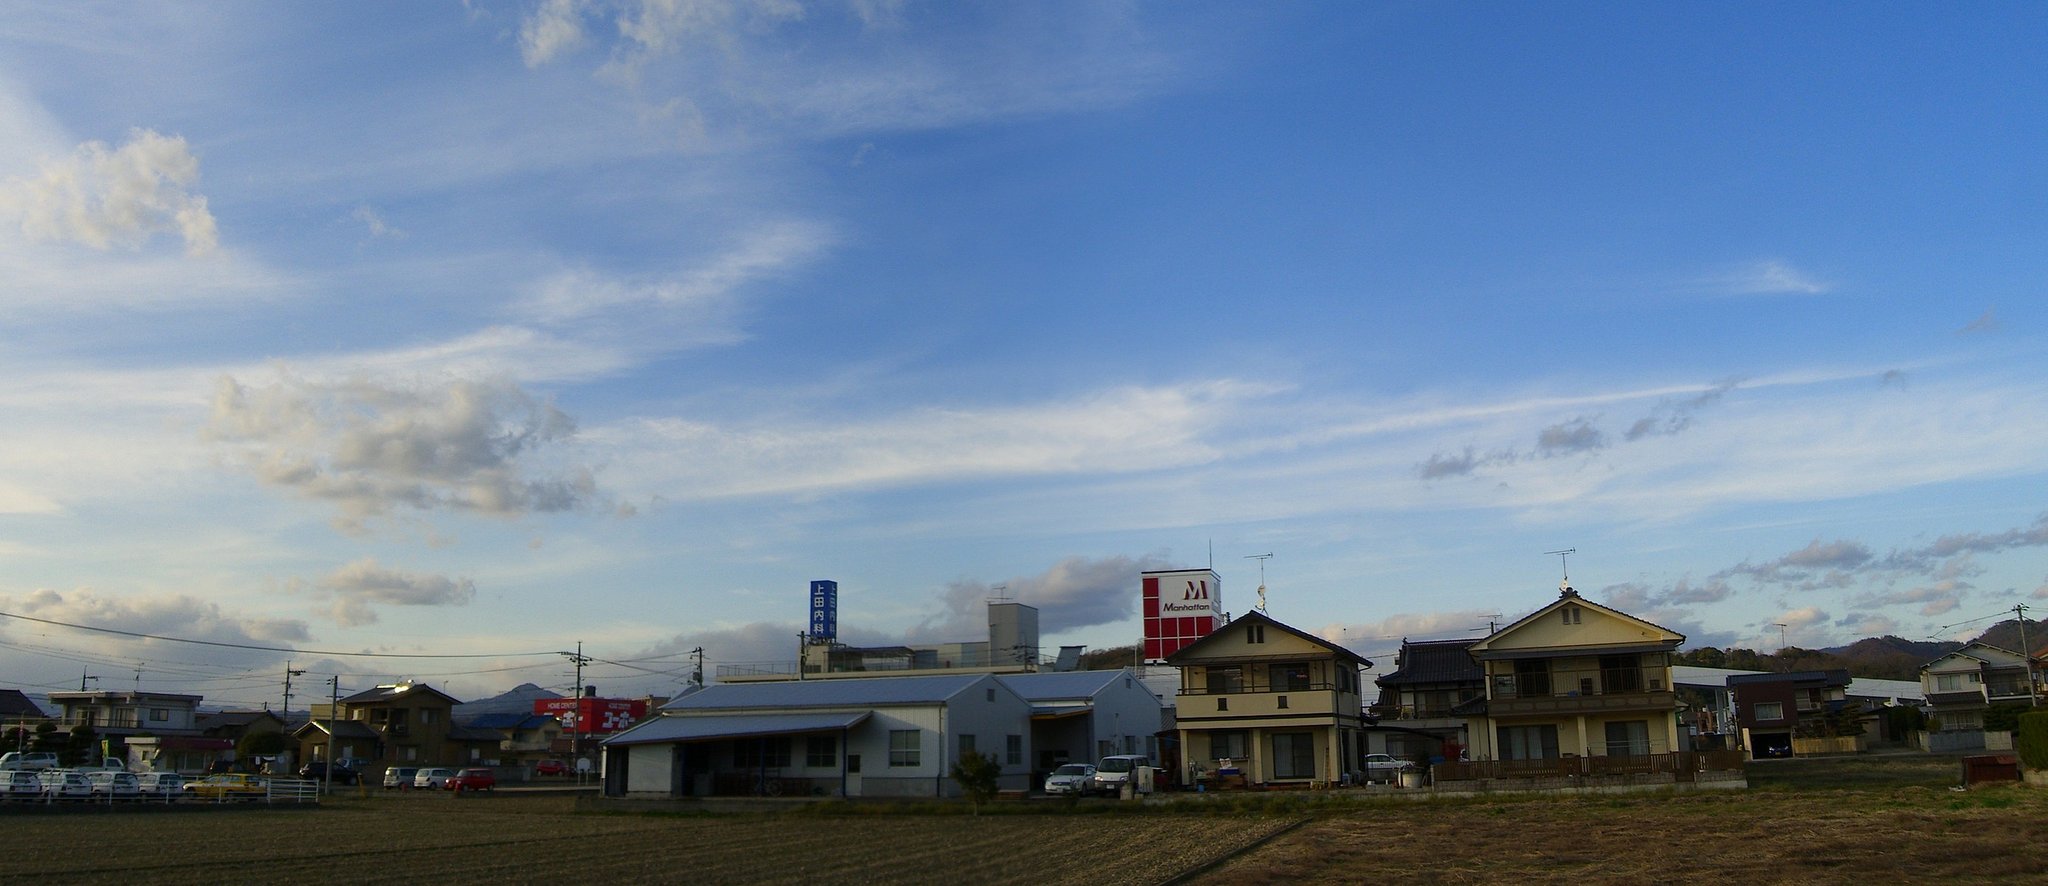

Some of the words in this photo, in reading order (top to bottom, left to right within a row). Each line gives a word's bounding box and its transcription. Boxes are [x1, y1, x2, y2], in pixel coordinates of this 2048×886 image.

[1183, 580, 1208, 600] M
[814, 584, 825, 634] 上田内科
[1163, 603, 1210, 612] Manhattan
